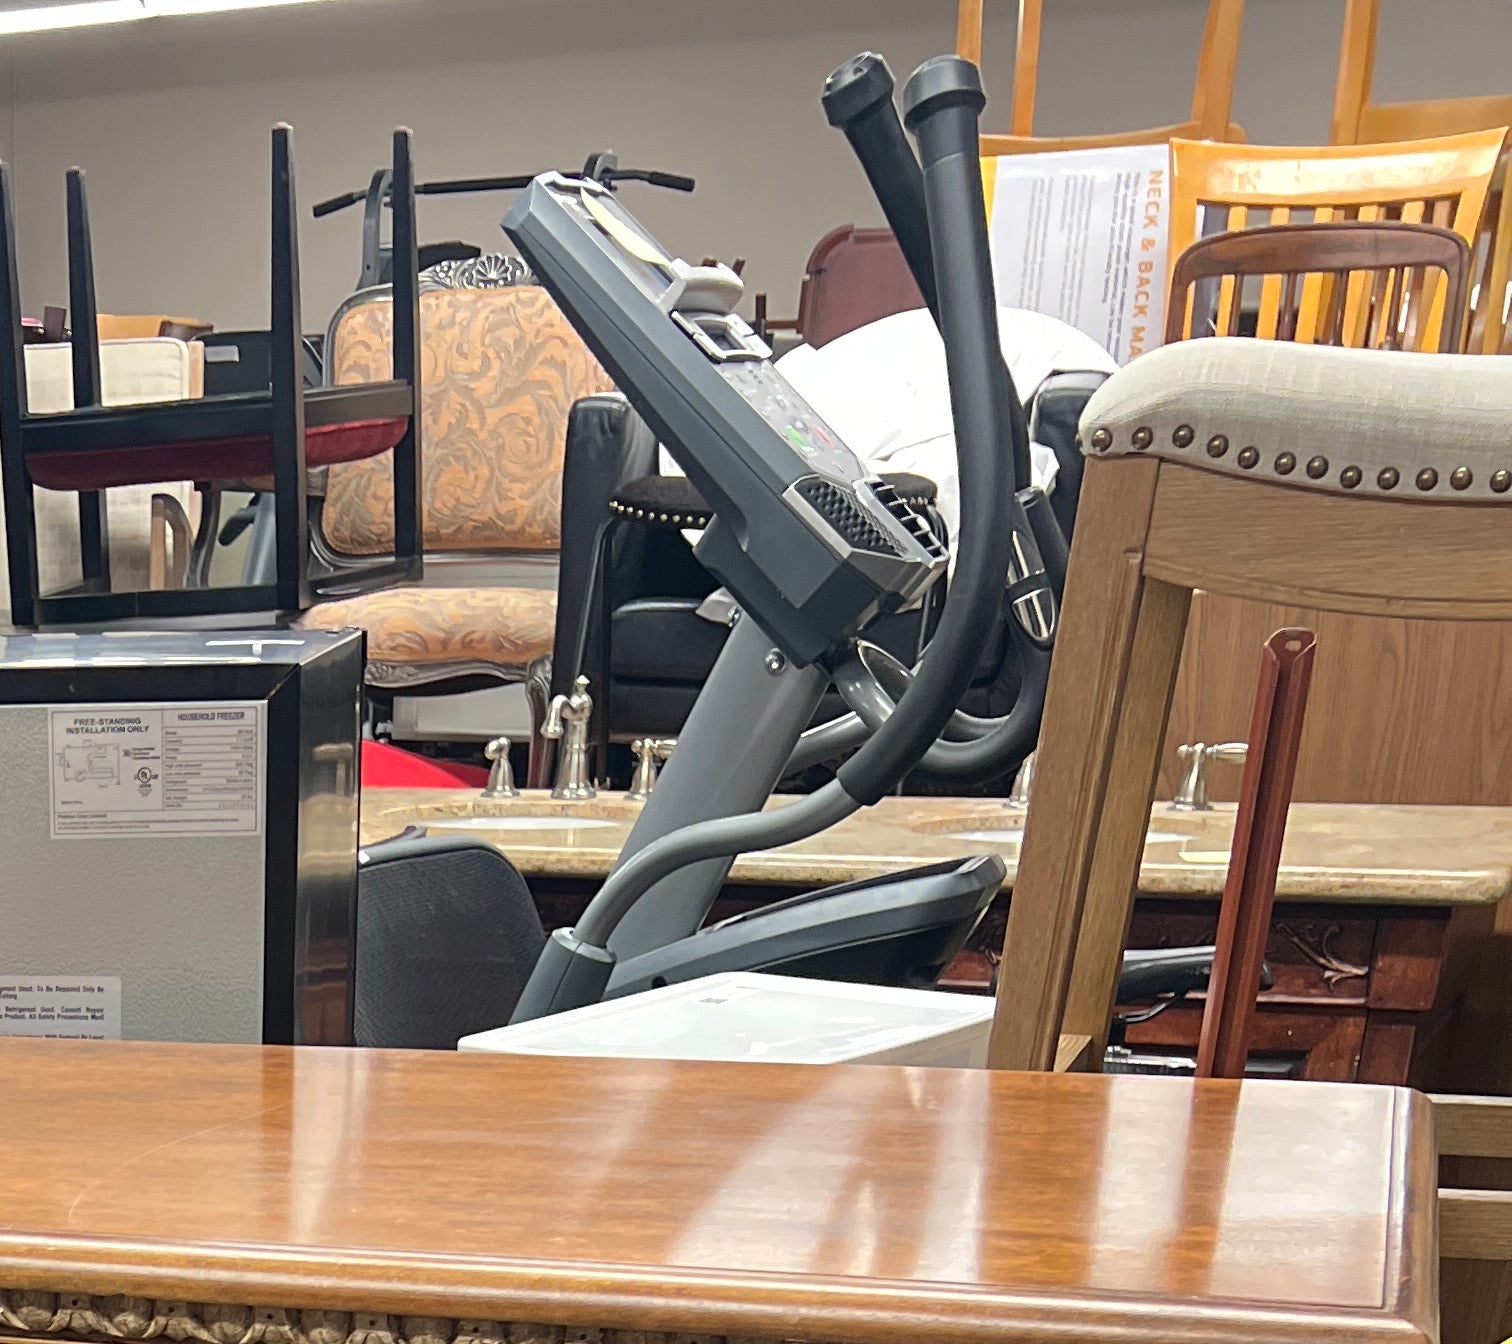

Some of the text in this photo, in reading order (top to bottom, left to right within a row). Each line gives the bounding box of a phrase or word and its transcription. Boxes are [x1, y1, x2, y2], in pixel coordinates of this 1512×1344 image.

[1143, 169, 1164, 229] NECK
[1141, 237, 1156, 251] &
[1132, 261, 1154, 318] BACK
